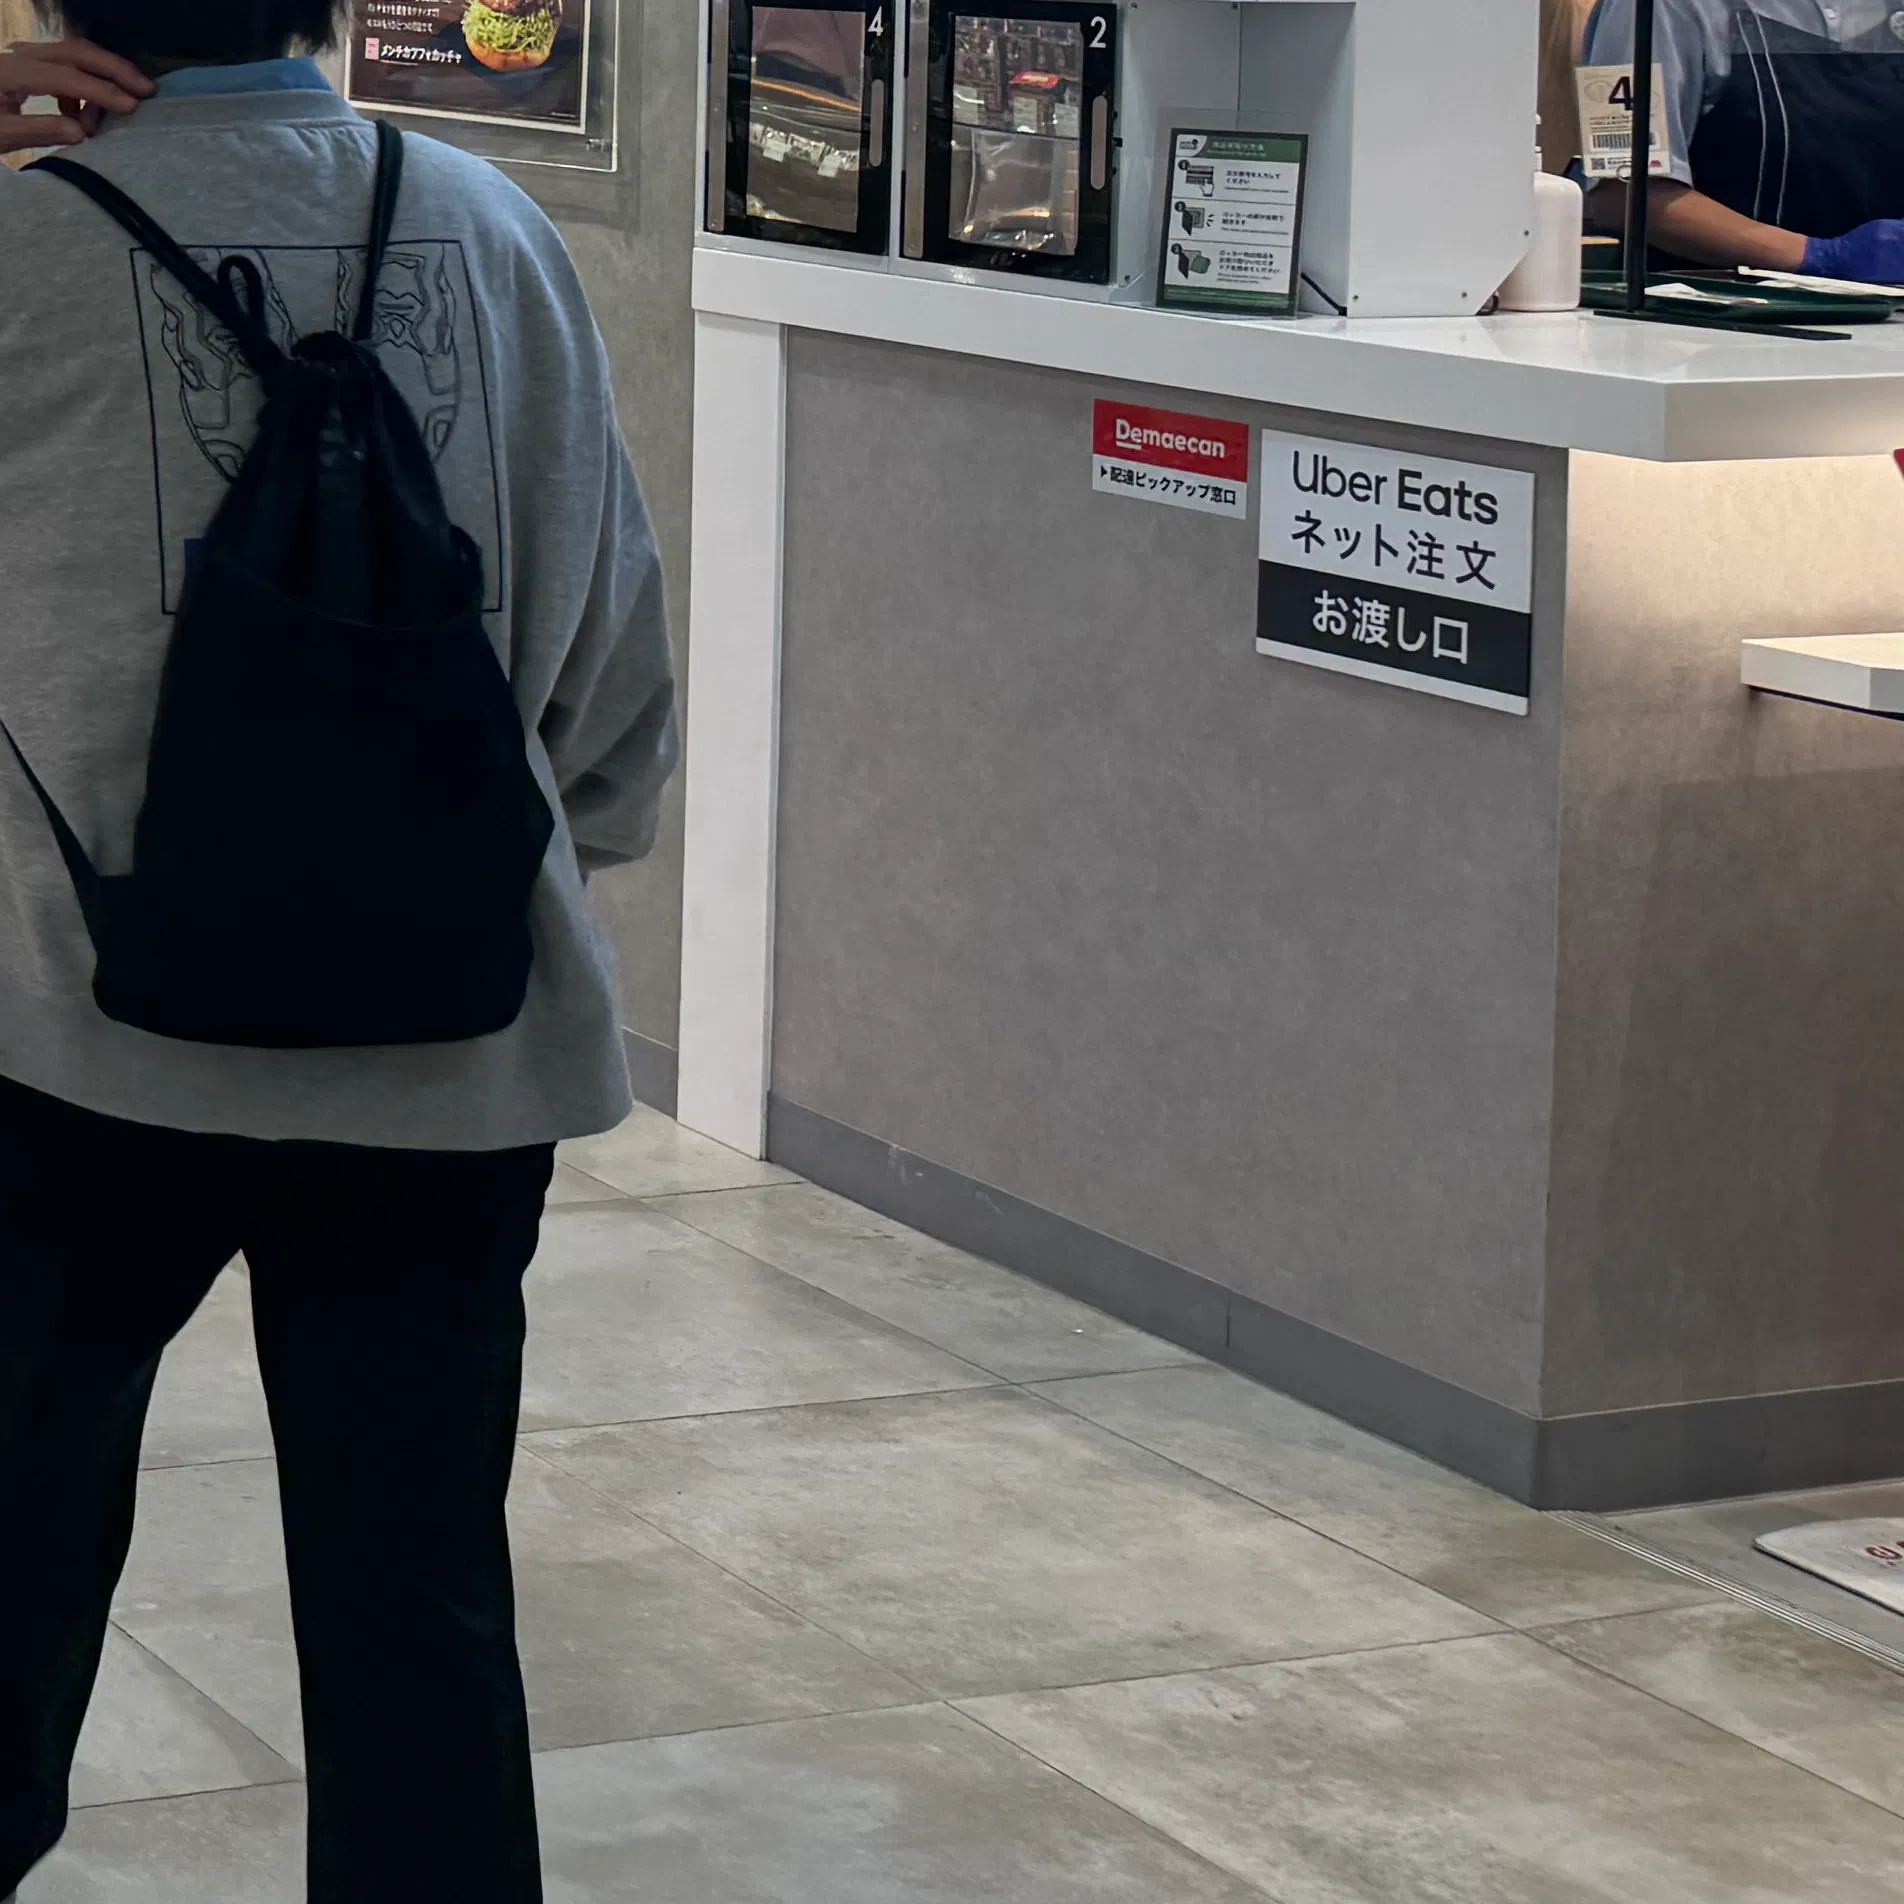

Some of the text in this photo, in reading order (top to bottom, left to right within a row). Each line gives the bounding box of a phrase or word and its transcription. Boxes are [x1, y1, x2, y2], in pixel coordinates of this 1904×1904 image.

[868, 5, 884, 38] 4
[1090, 16, 1108, 49] 2
[1115, 418, 1226, 459] Demaecan
[1110, 465, 1237, 506] 配達ピックアップ窓口
[1293, 450, 1499, 526] Uber Eats
[1290, 509, 1497, 591] ネット注文
[1312, 589, 1469, 665] お渡し口
